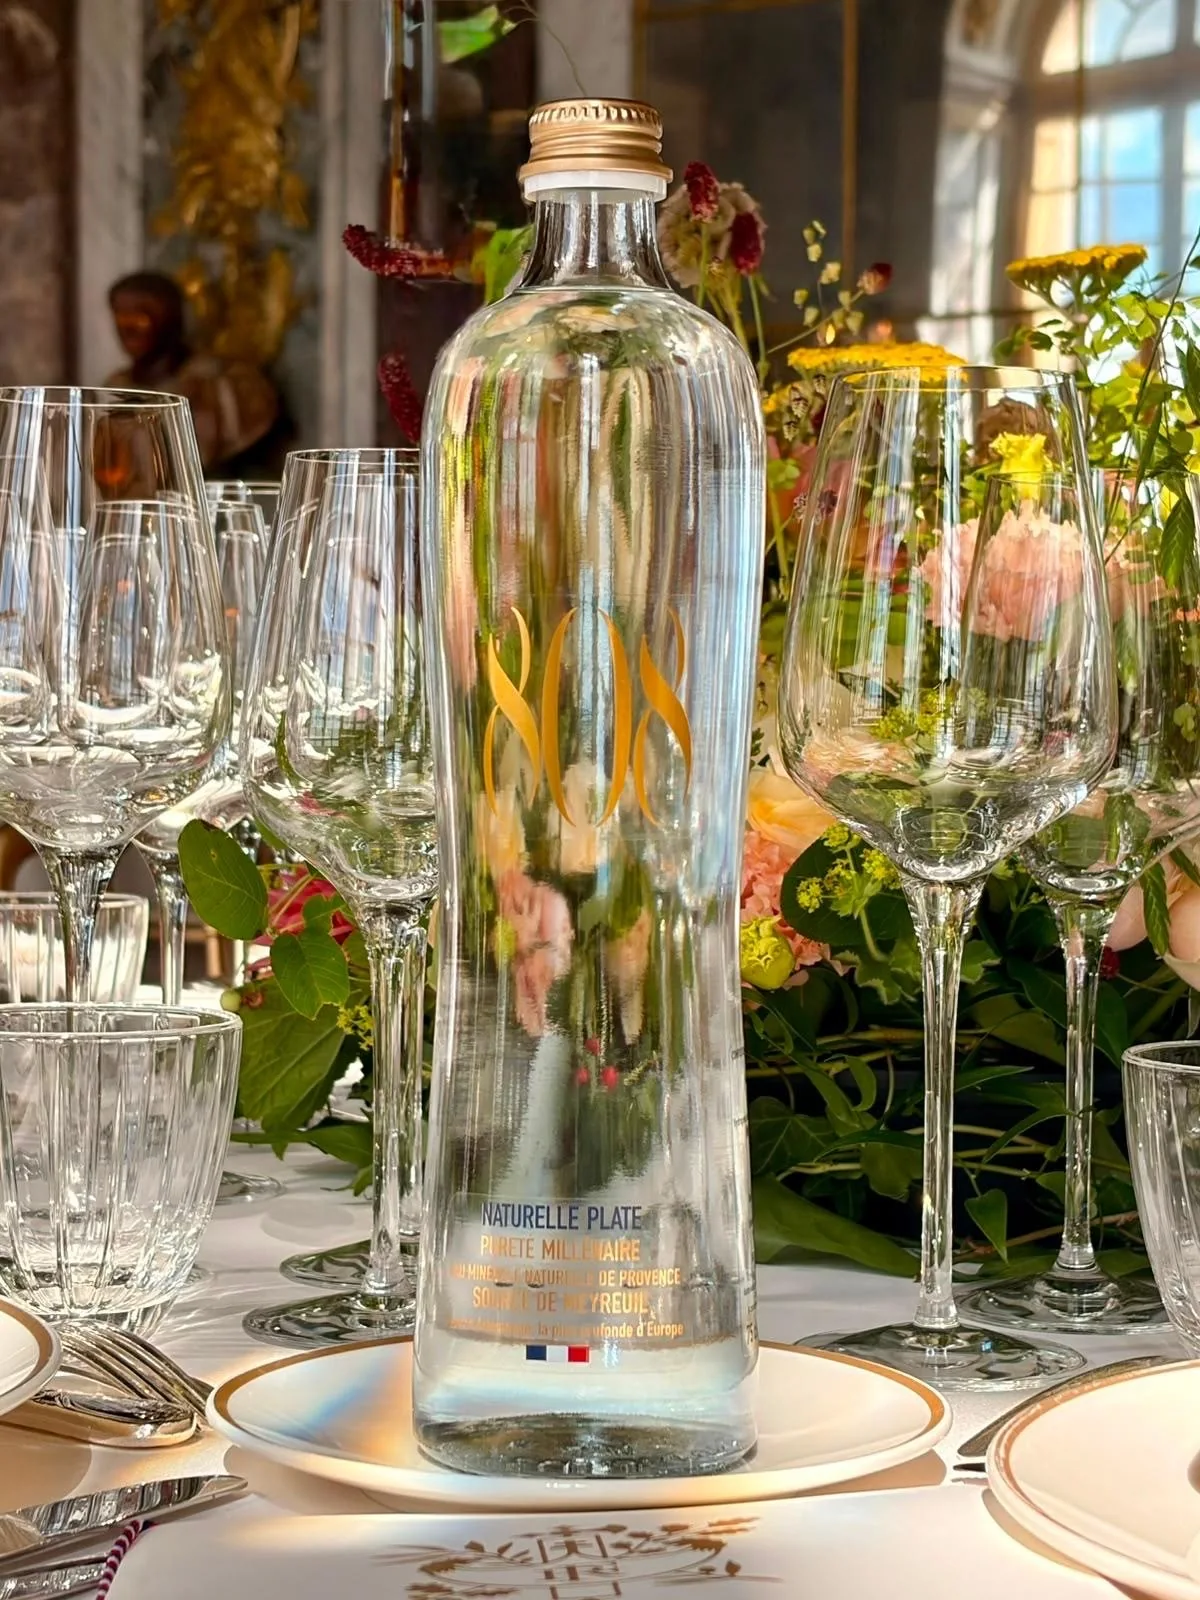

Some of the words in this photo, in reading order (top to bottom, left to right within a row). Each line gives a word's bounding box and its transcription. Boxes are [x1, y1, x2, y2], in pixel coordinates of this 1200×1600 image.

[481, 1201, 579, 1230] NATURELLE
[587, 1205, 642, 1230] PLATE
[599, 1269, 616, 1287] DE
[619, 1267, 681, 1288] PROVENCE
[536, 1291, 557, 1312] DE
